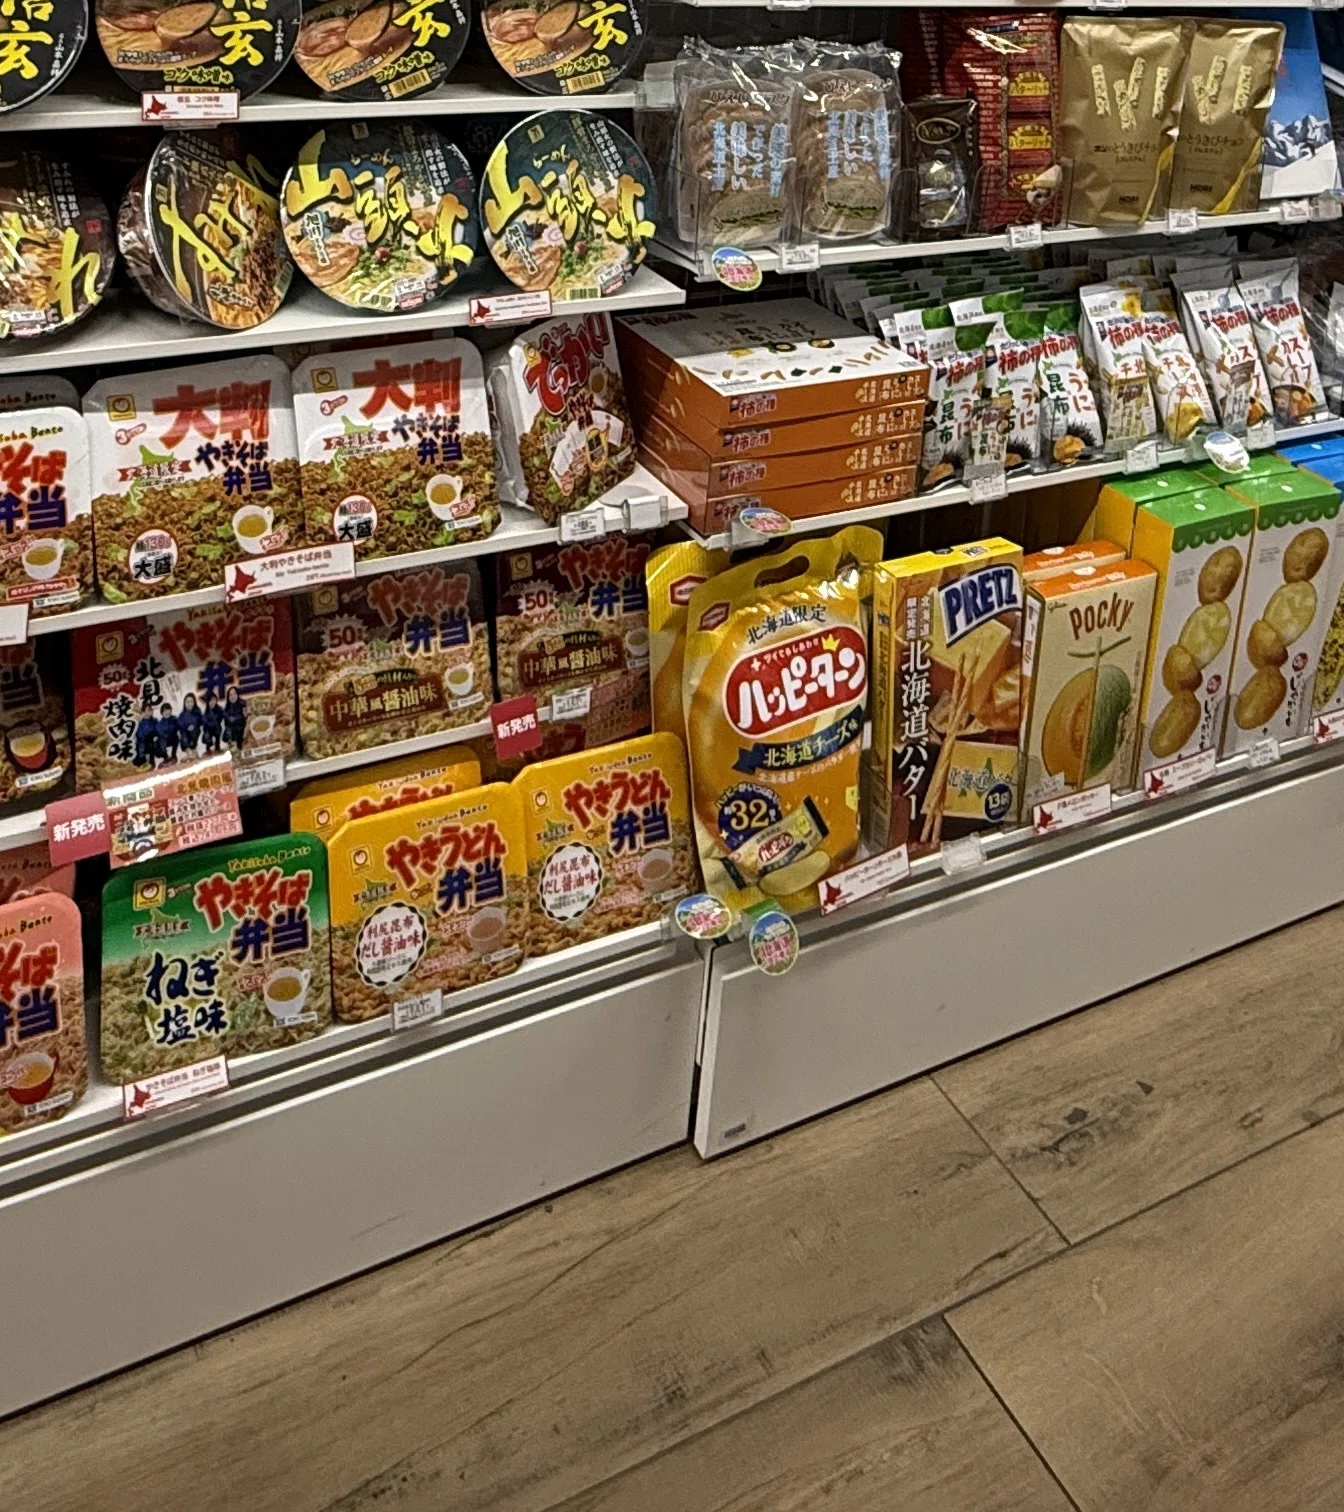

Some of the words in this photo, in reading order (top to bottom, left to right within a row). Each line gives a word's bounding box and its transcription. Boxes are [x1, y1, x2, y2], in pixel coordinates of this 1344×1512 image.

[1264, 302, 1300, 326] 柿の種
[355, 356, 463, 419] 大判
[1045, 372, 1071, 416] 昆布
[30, 425, 65, 442] Bento
[152, 378, 273, 448] 大判
[338, 517, 373, 543] 大盛
[134, 555, 174, 581] 大盛
[945, 565, 1018, 636] PRETZ
[747, 603, 828, 646] 北海道限定
[521, 637, 622, 677] 中華風醤油味
[327, 680, 441, 724] 中華風醤油味
[738, 646, 867, 732] ハッピーターン
[496, 714, 538, 740] 新発売
[762, 719, 860, 768] 北海道チーズ味
[899, 641, 932, 822] 北海道バター
[562, 768, 674, 826] やきうどん
[730, 800, 772, 829] 32
[52, 812, 106, 843] 新発売
[386, 821, 509, 889] やきうどん
[364, 912, 418, 941] 利尻昆布
[144, 951, 224, 1007] ねぎ
[157, 1001, 229, 1049] 塩味
